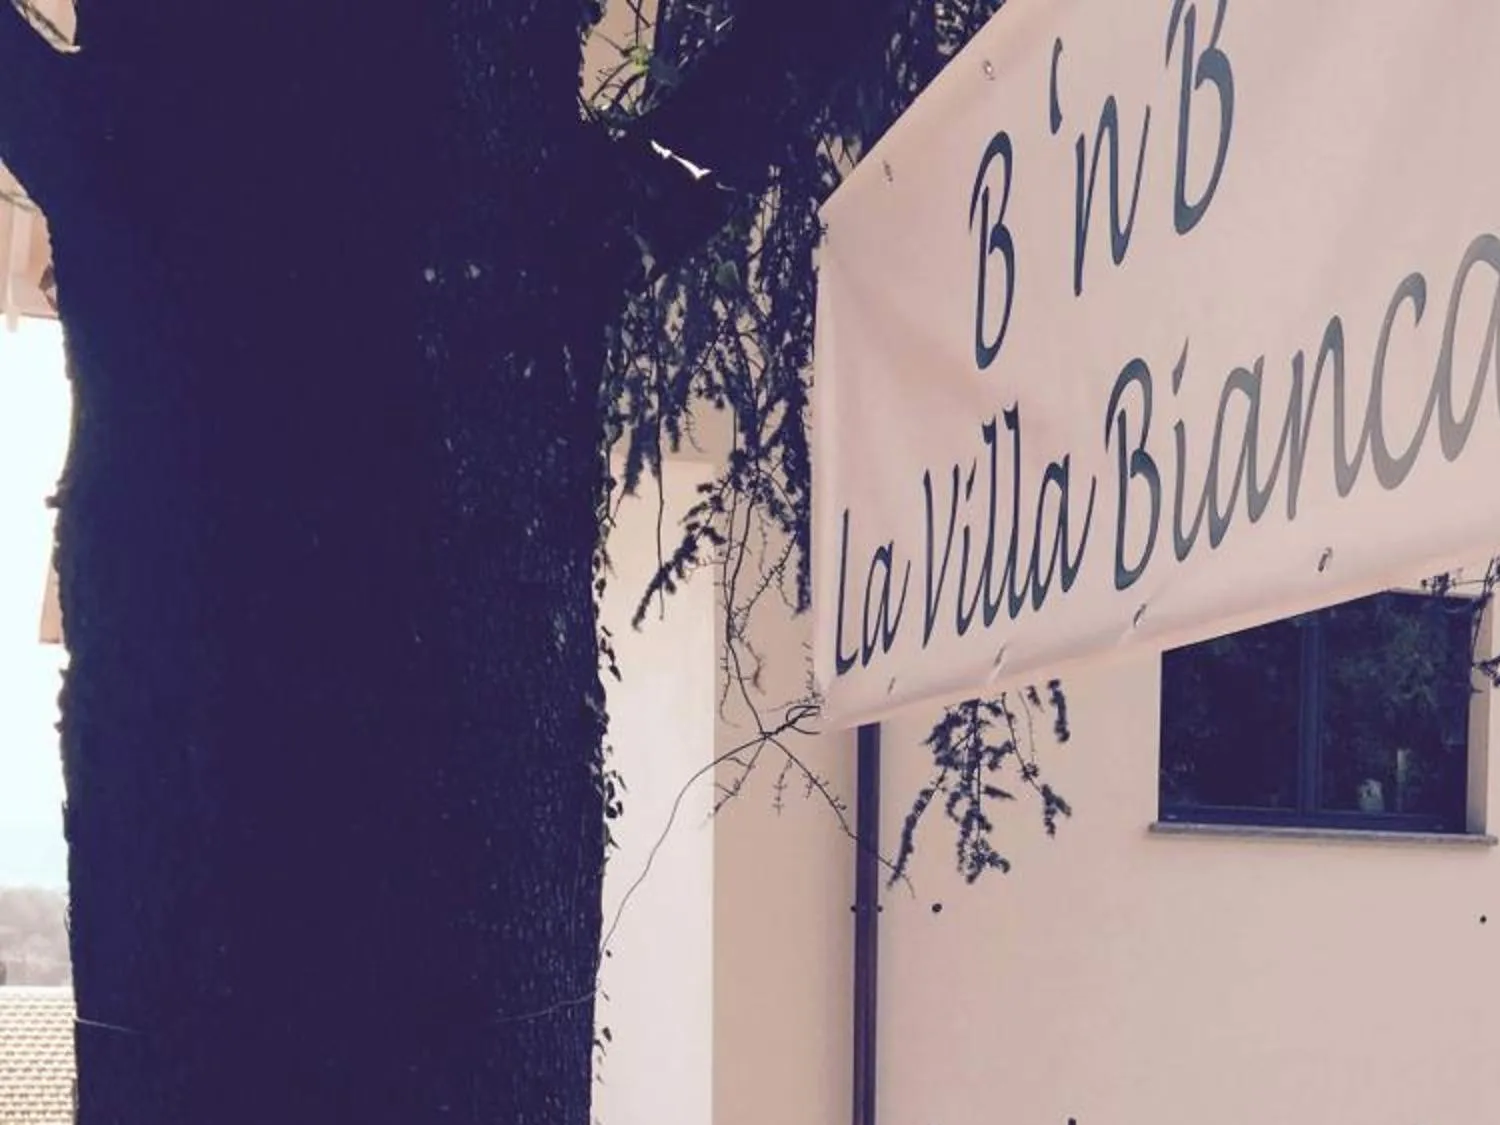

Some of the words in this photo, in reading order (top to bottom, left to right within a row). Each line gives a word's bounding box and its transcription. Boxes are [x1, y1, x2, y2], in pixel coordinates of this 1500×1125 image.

[968, 129, 1016, 371] B
[1164, 0, 1235, 236] B
[834, 507, 912, 677] La
[921, 400, 1097, 650] Villa
